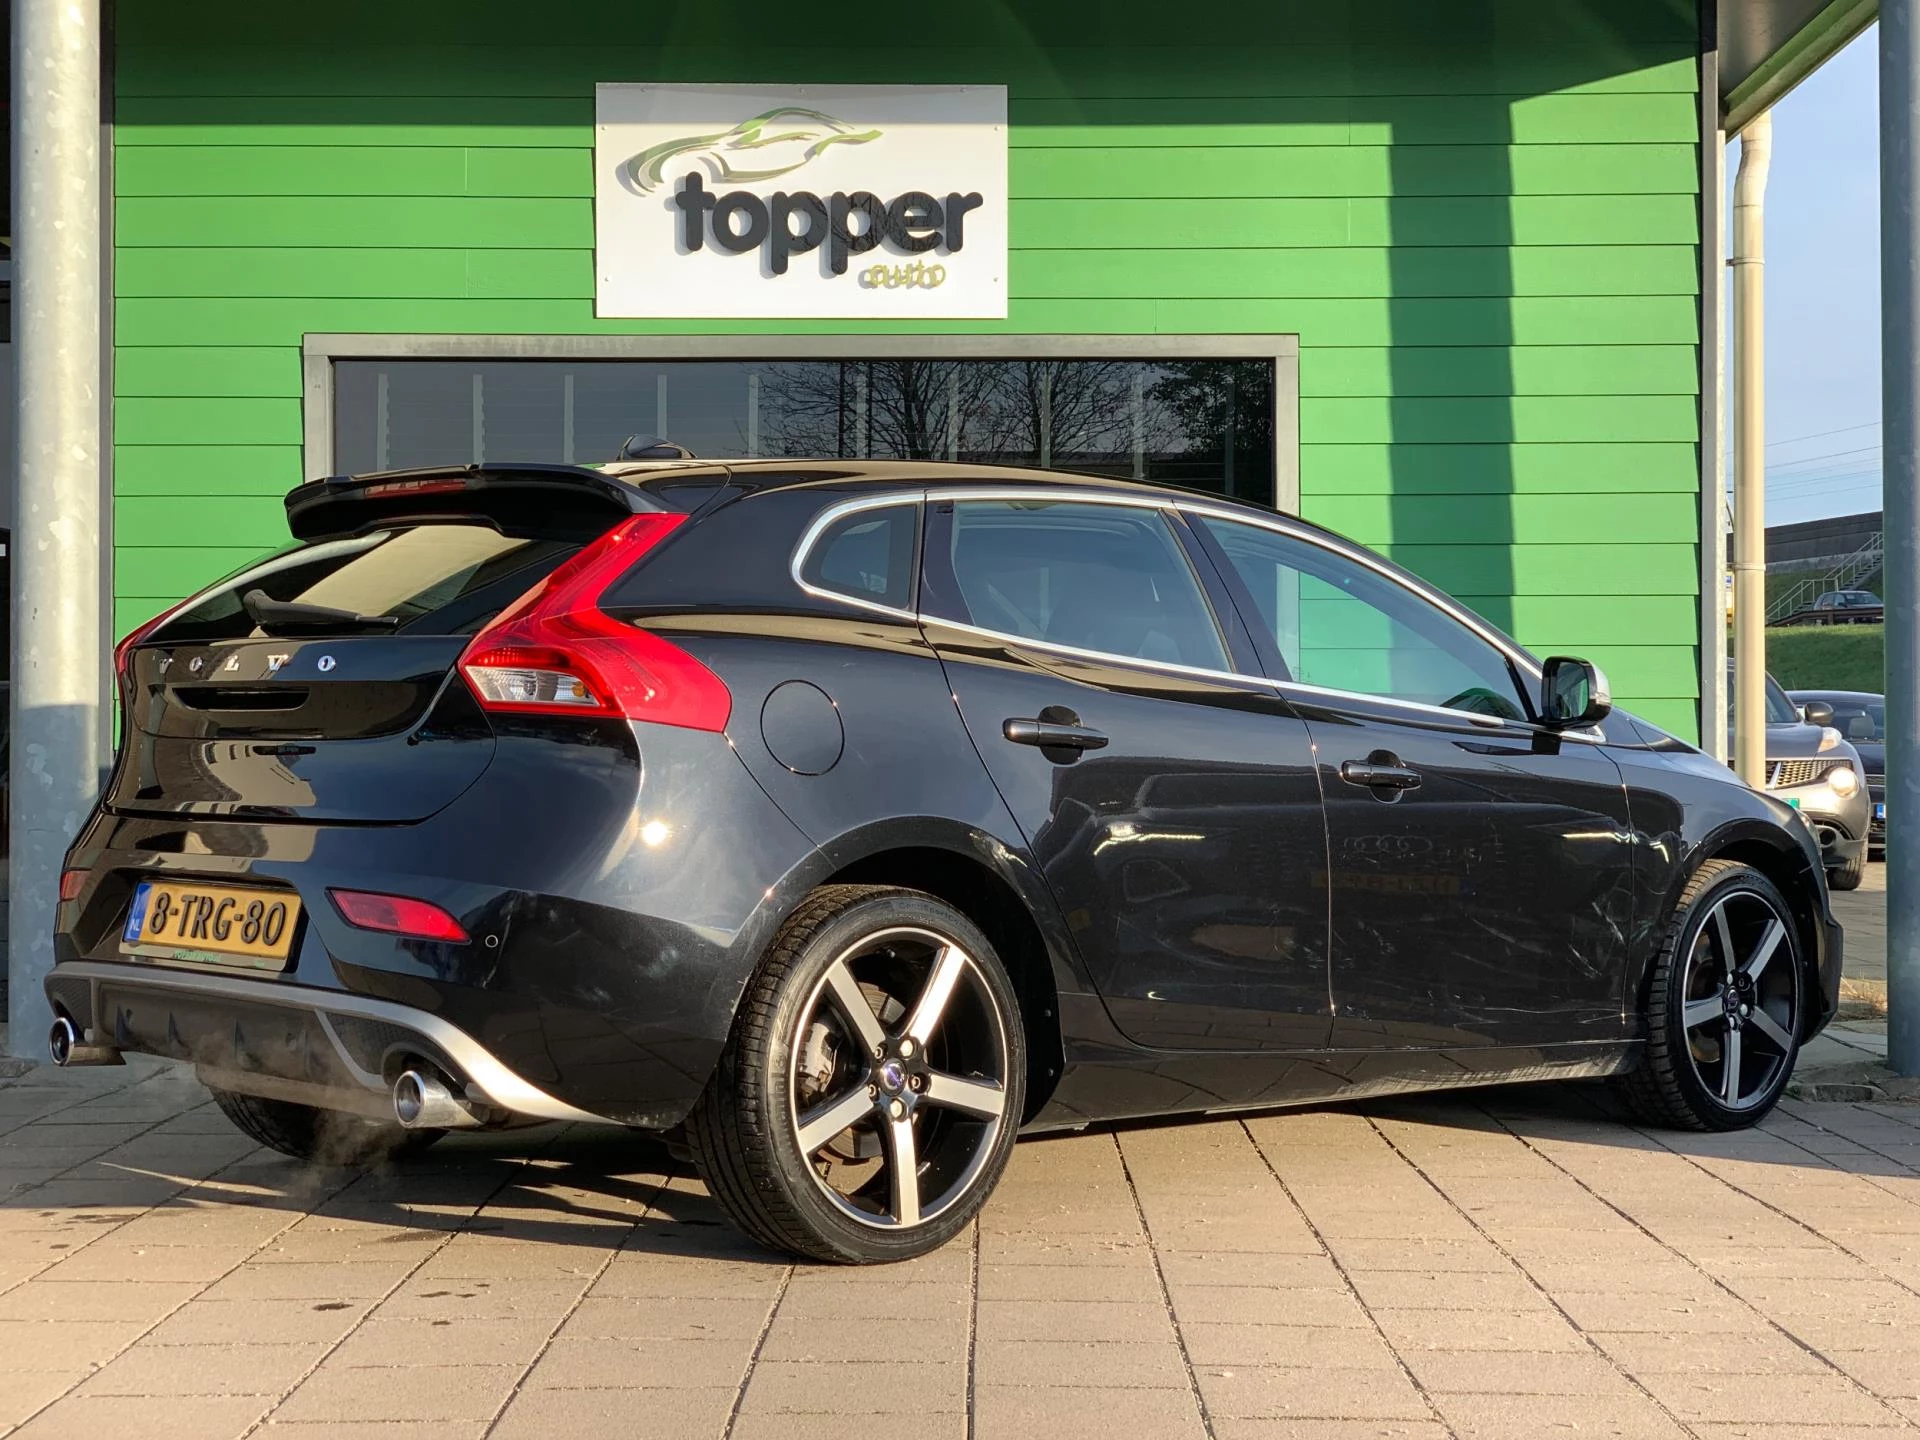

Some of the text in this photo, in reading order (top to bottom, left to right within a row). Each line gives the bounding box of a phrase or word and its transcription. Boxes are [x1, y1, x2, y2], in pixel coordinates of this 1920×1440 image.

[675, 171, 983, 275] topper
[869, 259, 946, 286] auto
[158, 654, 337, 674] VOLVO
[149, 891, 286, 947] 8-TRG-80
